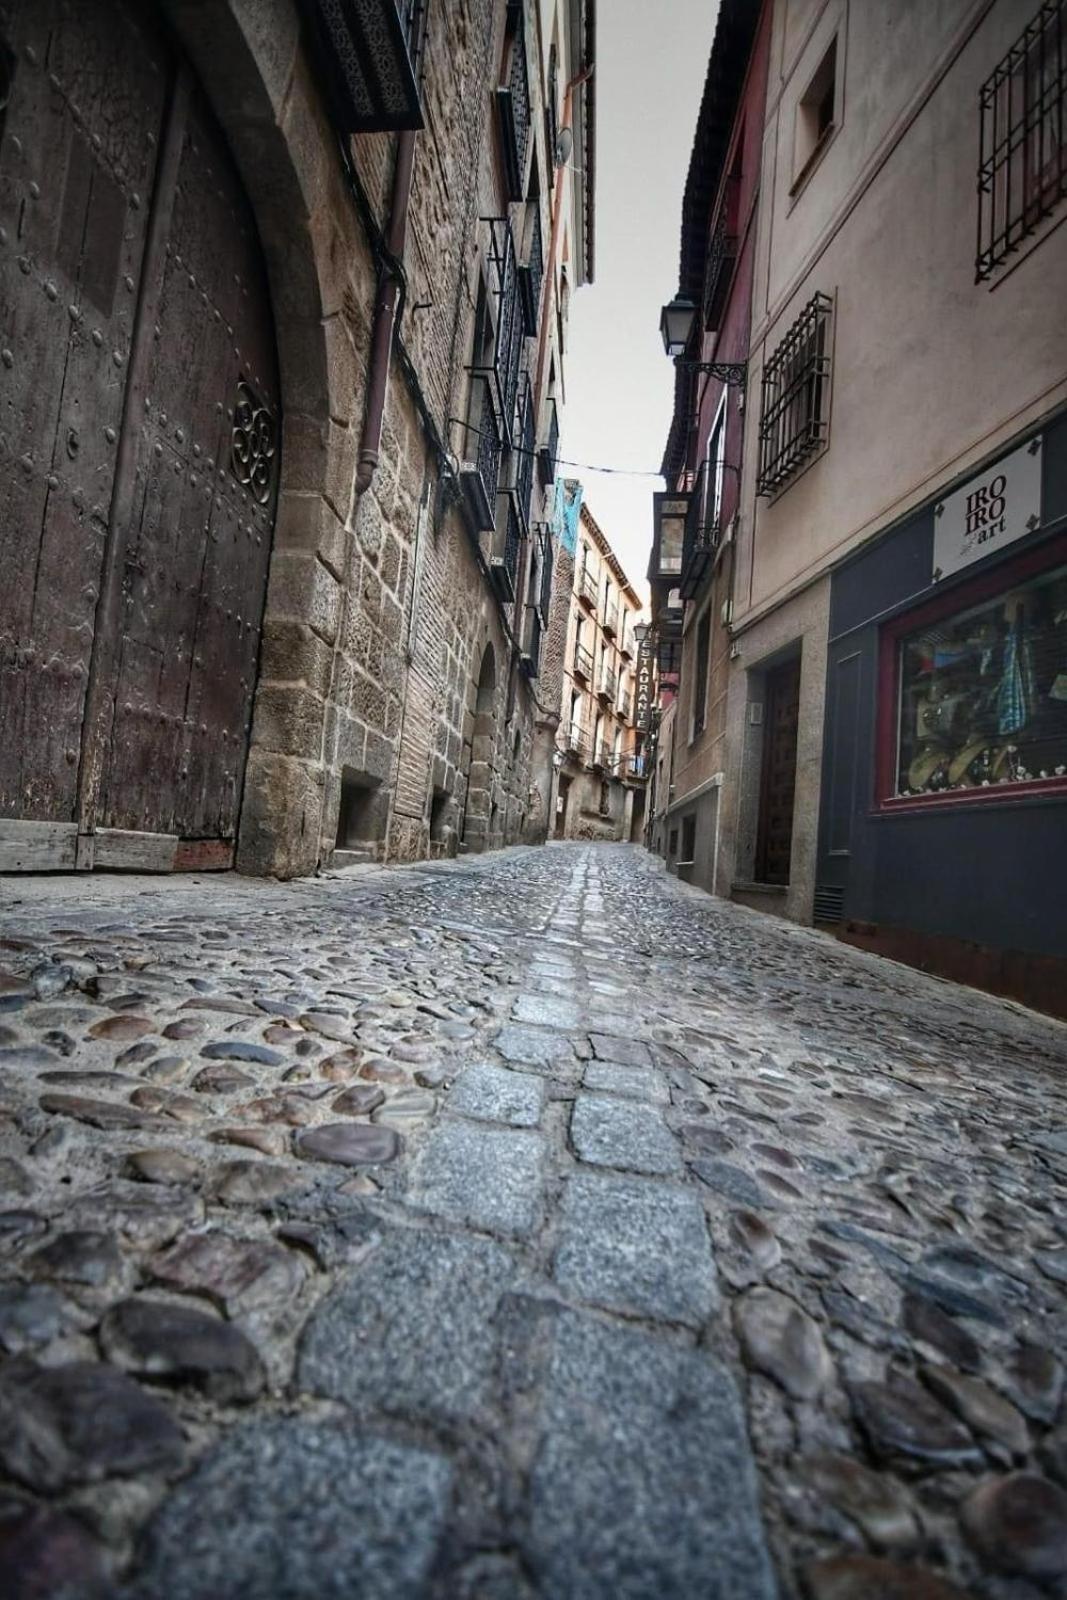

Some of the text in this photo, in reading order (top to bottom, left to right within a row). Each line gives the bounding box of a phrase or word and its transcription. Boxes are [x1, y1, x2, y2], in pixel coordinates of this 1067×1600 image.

[965, 475, 1006, 515] IRO
[964, 496, 1006, 536] IRO
[977, 515, 1006, 544] art
[636, 630, 652, 728] ESTAURANTE
